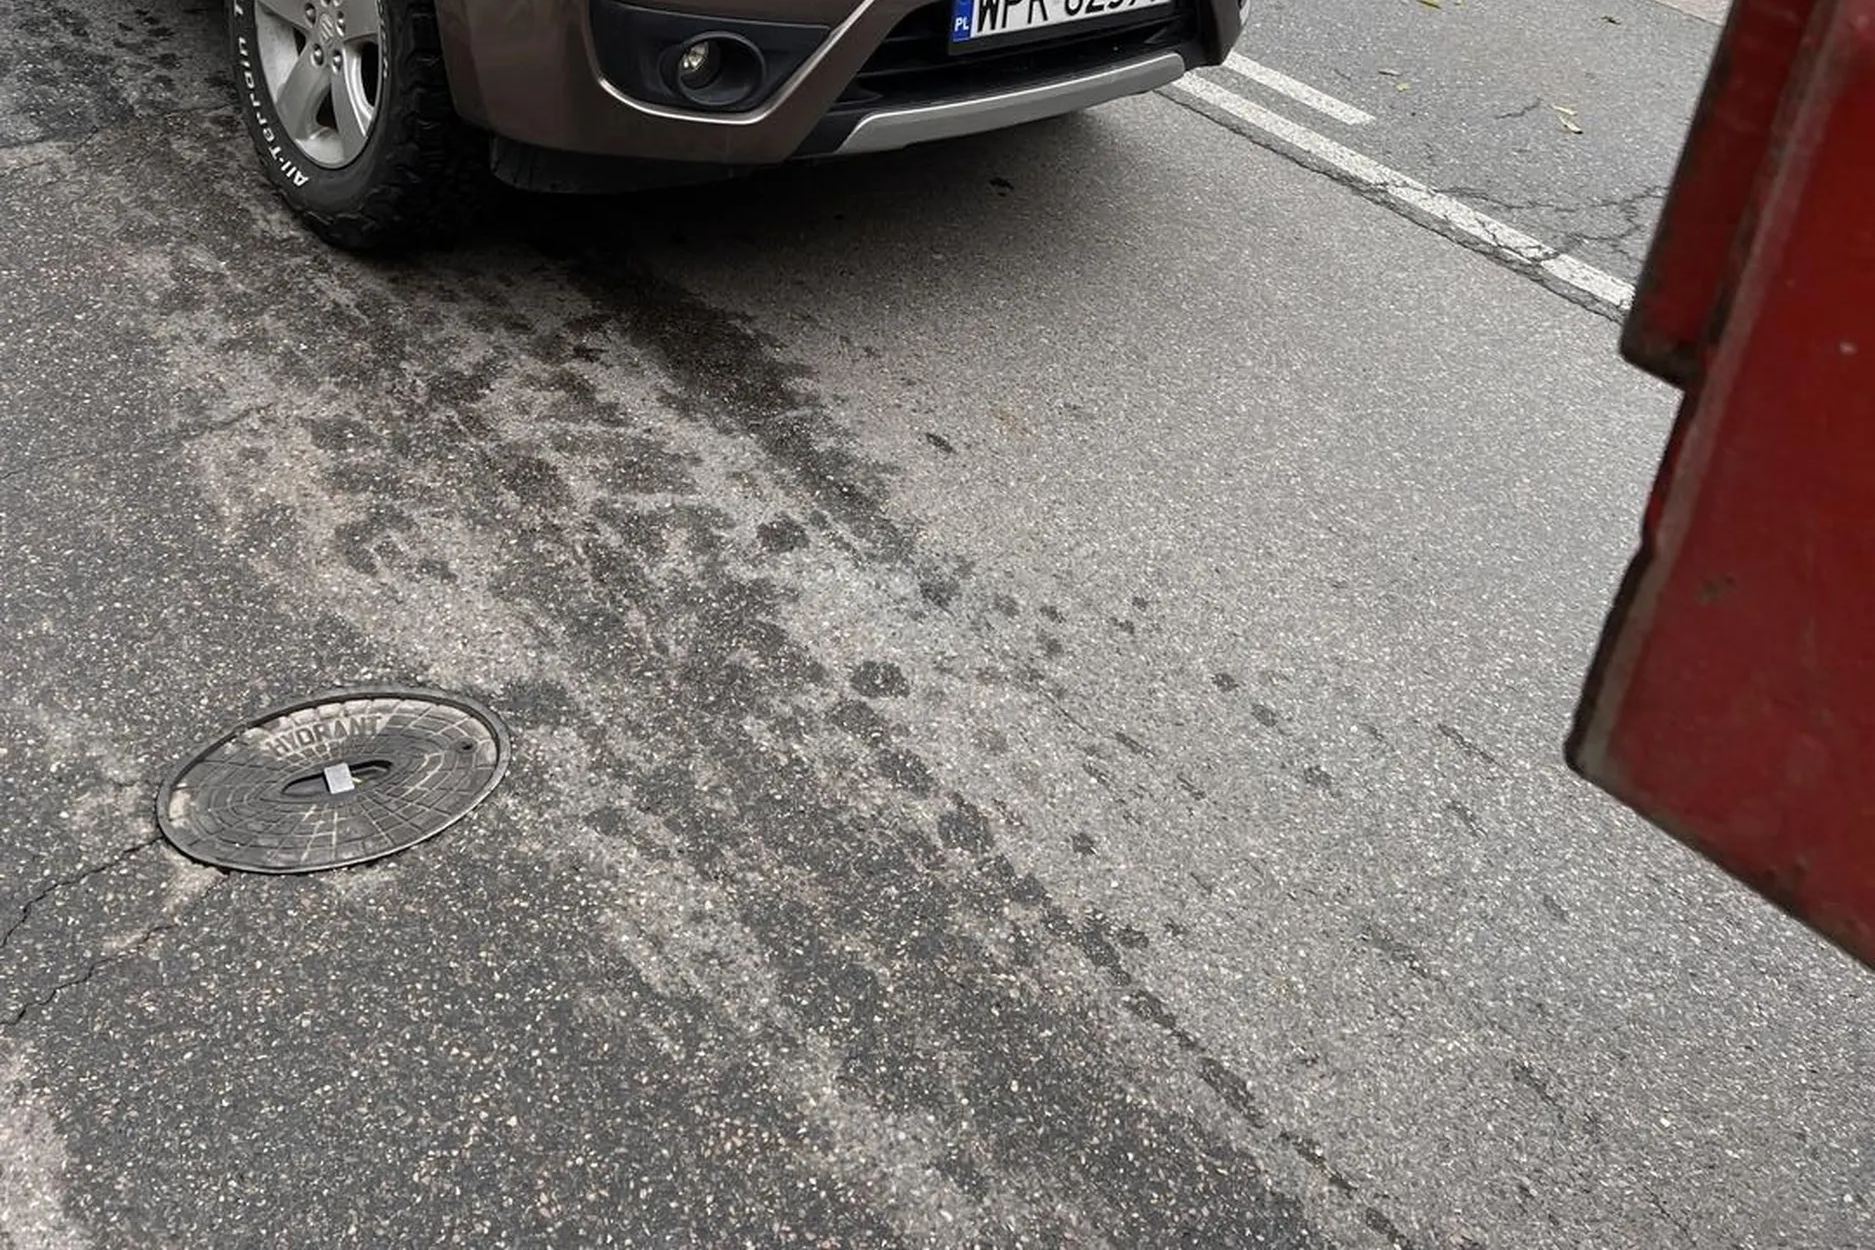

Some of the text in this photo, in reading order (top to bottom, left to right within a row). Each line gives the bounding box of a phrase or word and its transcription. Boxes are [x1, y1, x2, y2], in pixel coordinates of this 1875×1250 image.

[954, 16, 970, 32] PL
[238, 36, 310, 188] All-Terrain
[264, 713, 381, 756] HYDRANT
